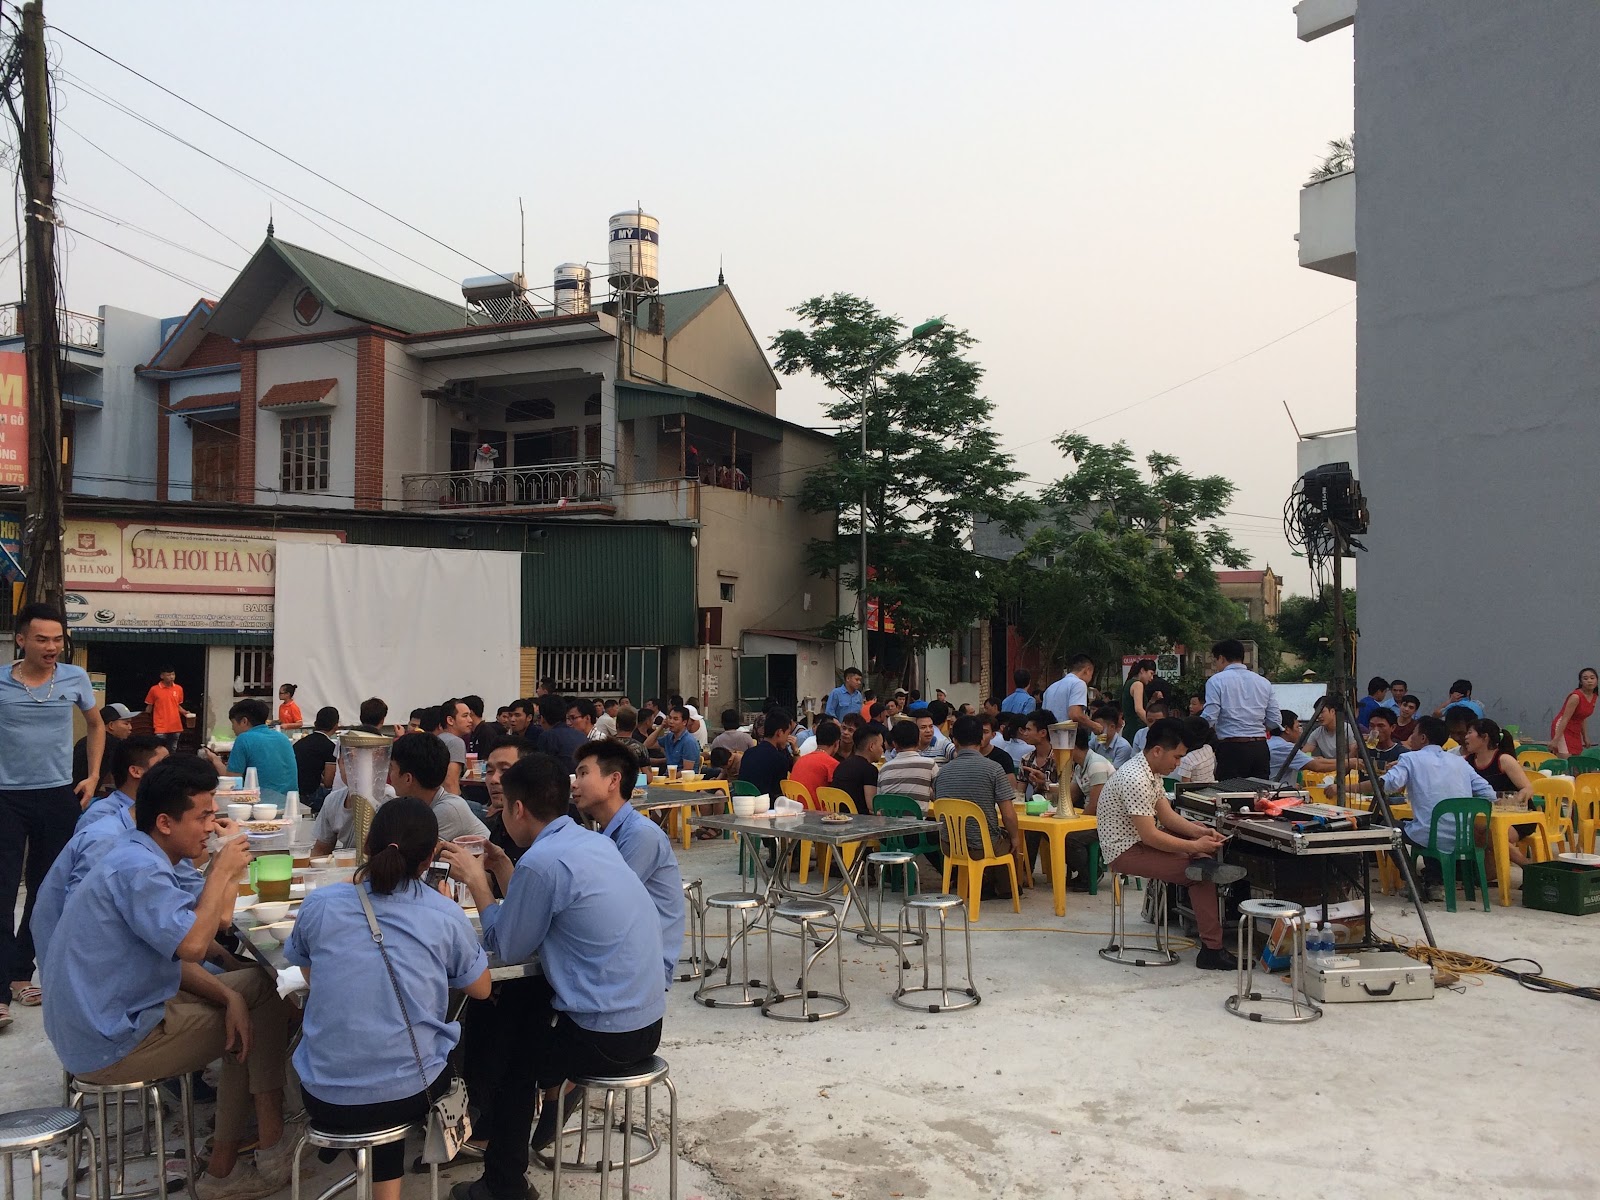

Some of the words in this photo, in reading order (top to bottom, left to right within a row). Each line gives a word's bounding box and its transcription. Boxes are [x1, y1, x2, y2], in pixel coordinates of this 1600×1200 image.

[6, 473, 25, 483] 075
[132, 547, 168, 570] BIA
[173, 549, 208, 571] HƠI
[214, 548, 242, 572] HÀ
[247, 549, 276, 576] NỘ
[66, 564, 76, 573] IA
[243, 603, 274, 613] BAKE
